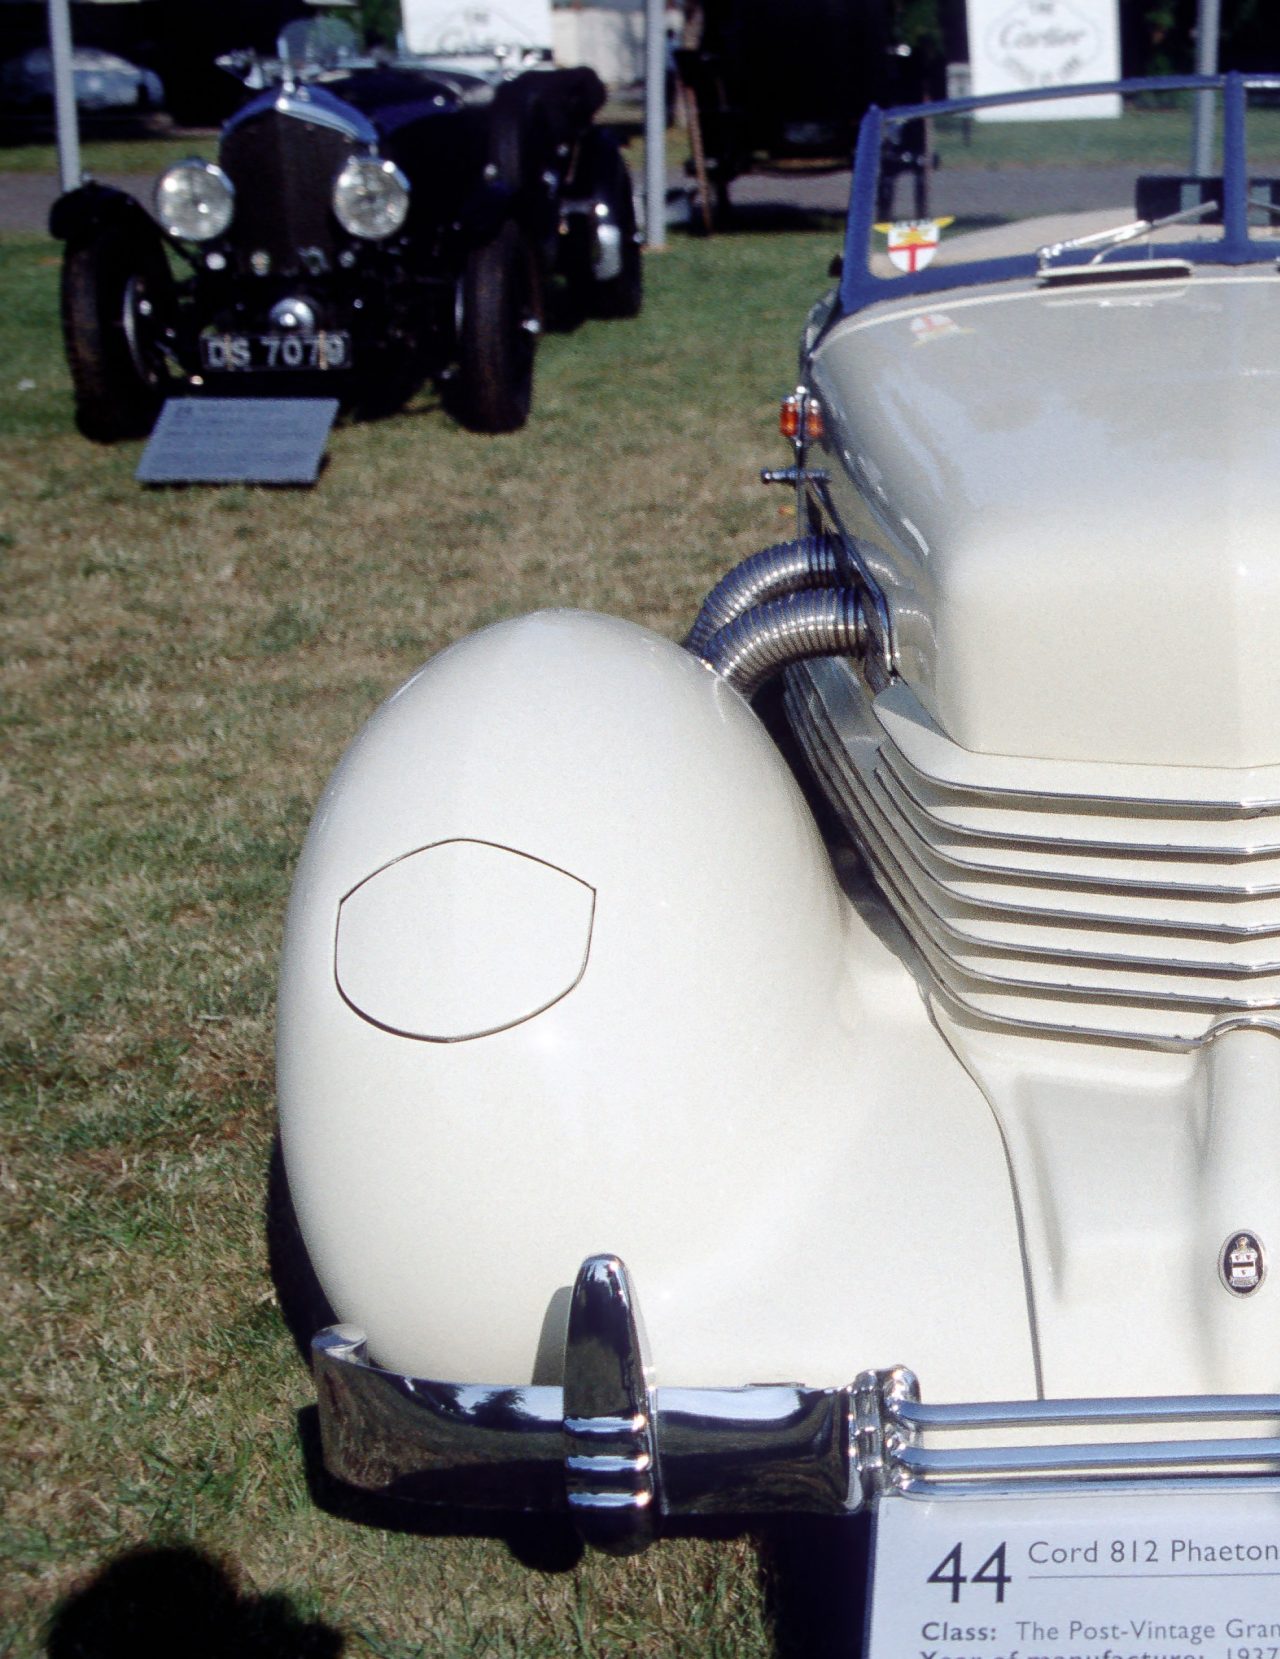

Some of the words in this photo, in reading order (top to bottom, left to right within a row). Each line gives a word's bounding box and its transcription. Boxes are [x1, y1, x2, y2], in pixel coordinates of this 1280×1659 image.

[926, 1540, 1013, 1604] 44
[1027, 1540, 1099, 1564] Cord
[1110, 1539, 1160, 1563] 812
[1170, 1537, 1280, 1563] Phaeton
[920, 1620, 998, 1642] Class:
[1014, 1620, 1060, 1641] The
[1069, 1618, 1216, 1646] Post-Vintage
